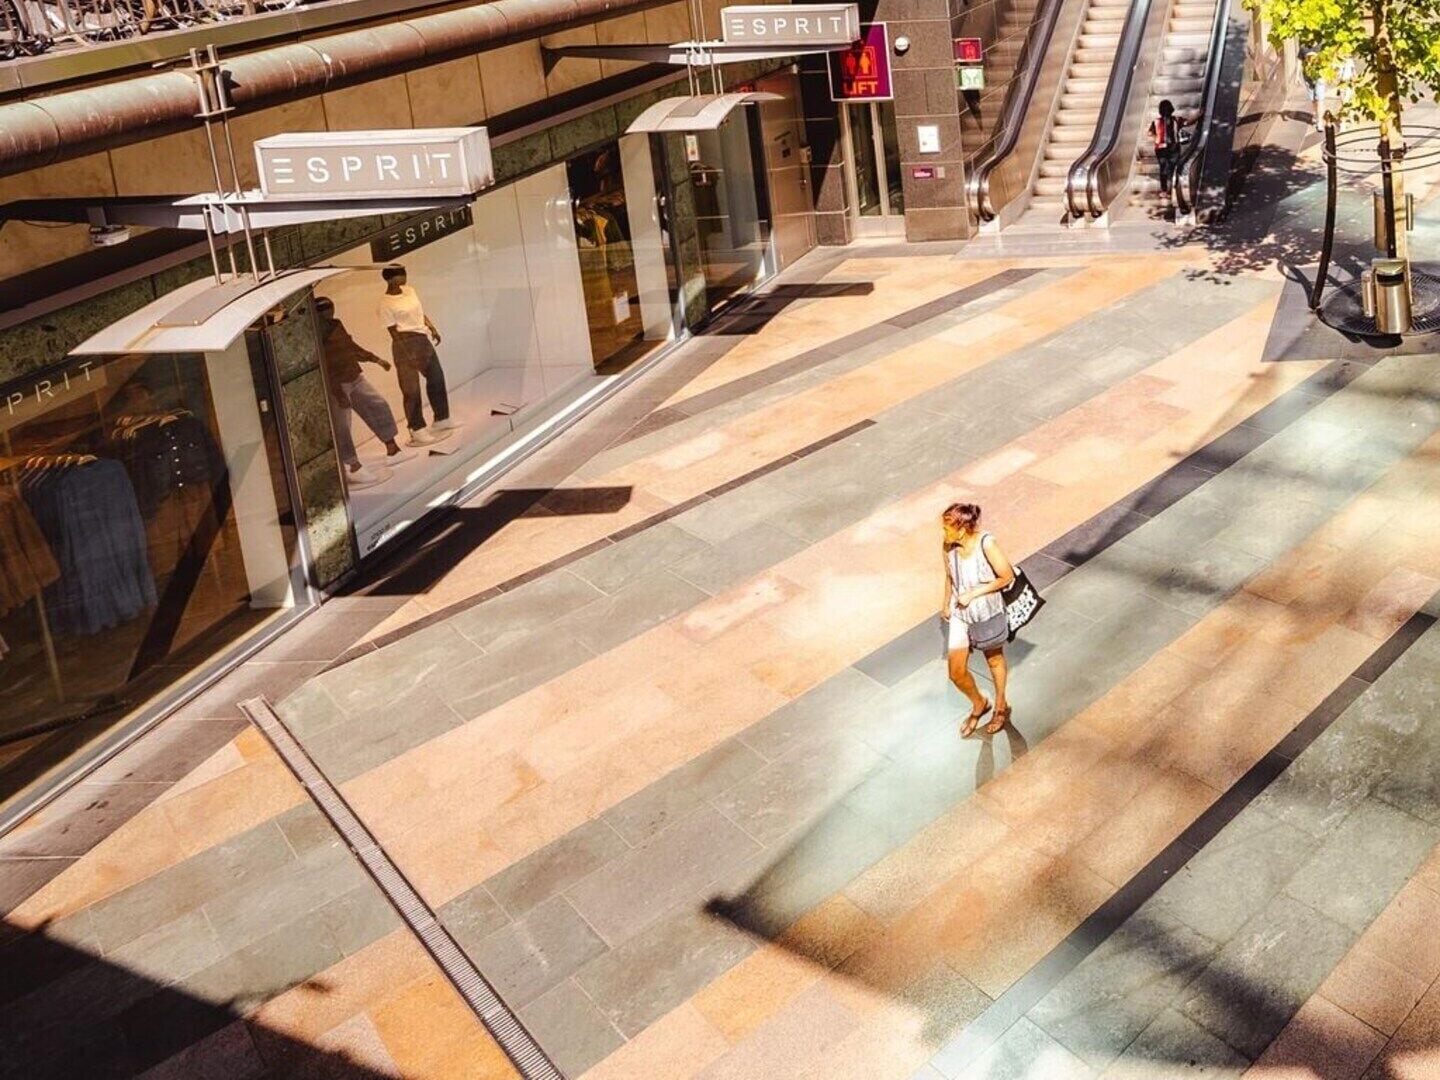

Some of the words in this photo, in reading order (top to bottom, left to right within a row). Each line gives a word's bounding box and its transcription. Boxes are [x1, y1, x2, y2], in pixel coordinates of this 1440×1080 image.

[730, 16, 842, 36] ESPRIT
[843, 80, 878, 95] LIFT
[271, 152, 452, 184] ESPRIT
[389, 205, 468, 251] ESPRIT
